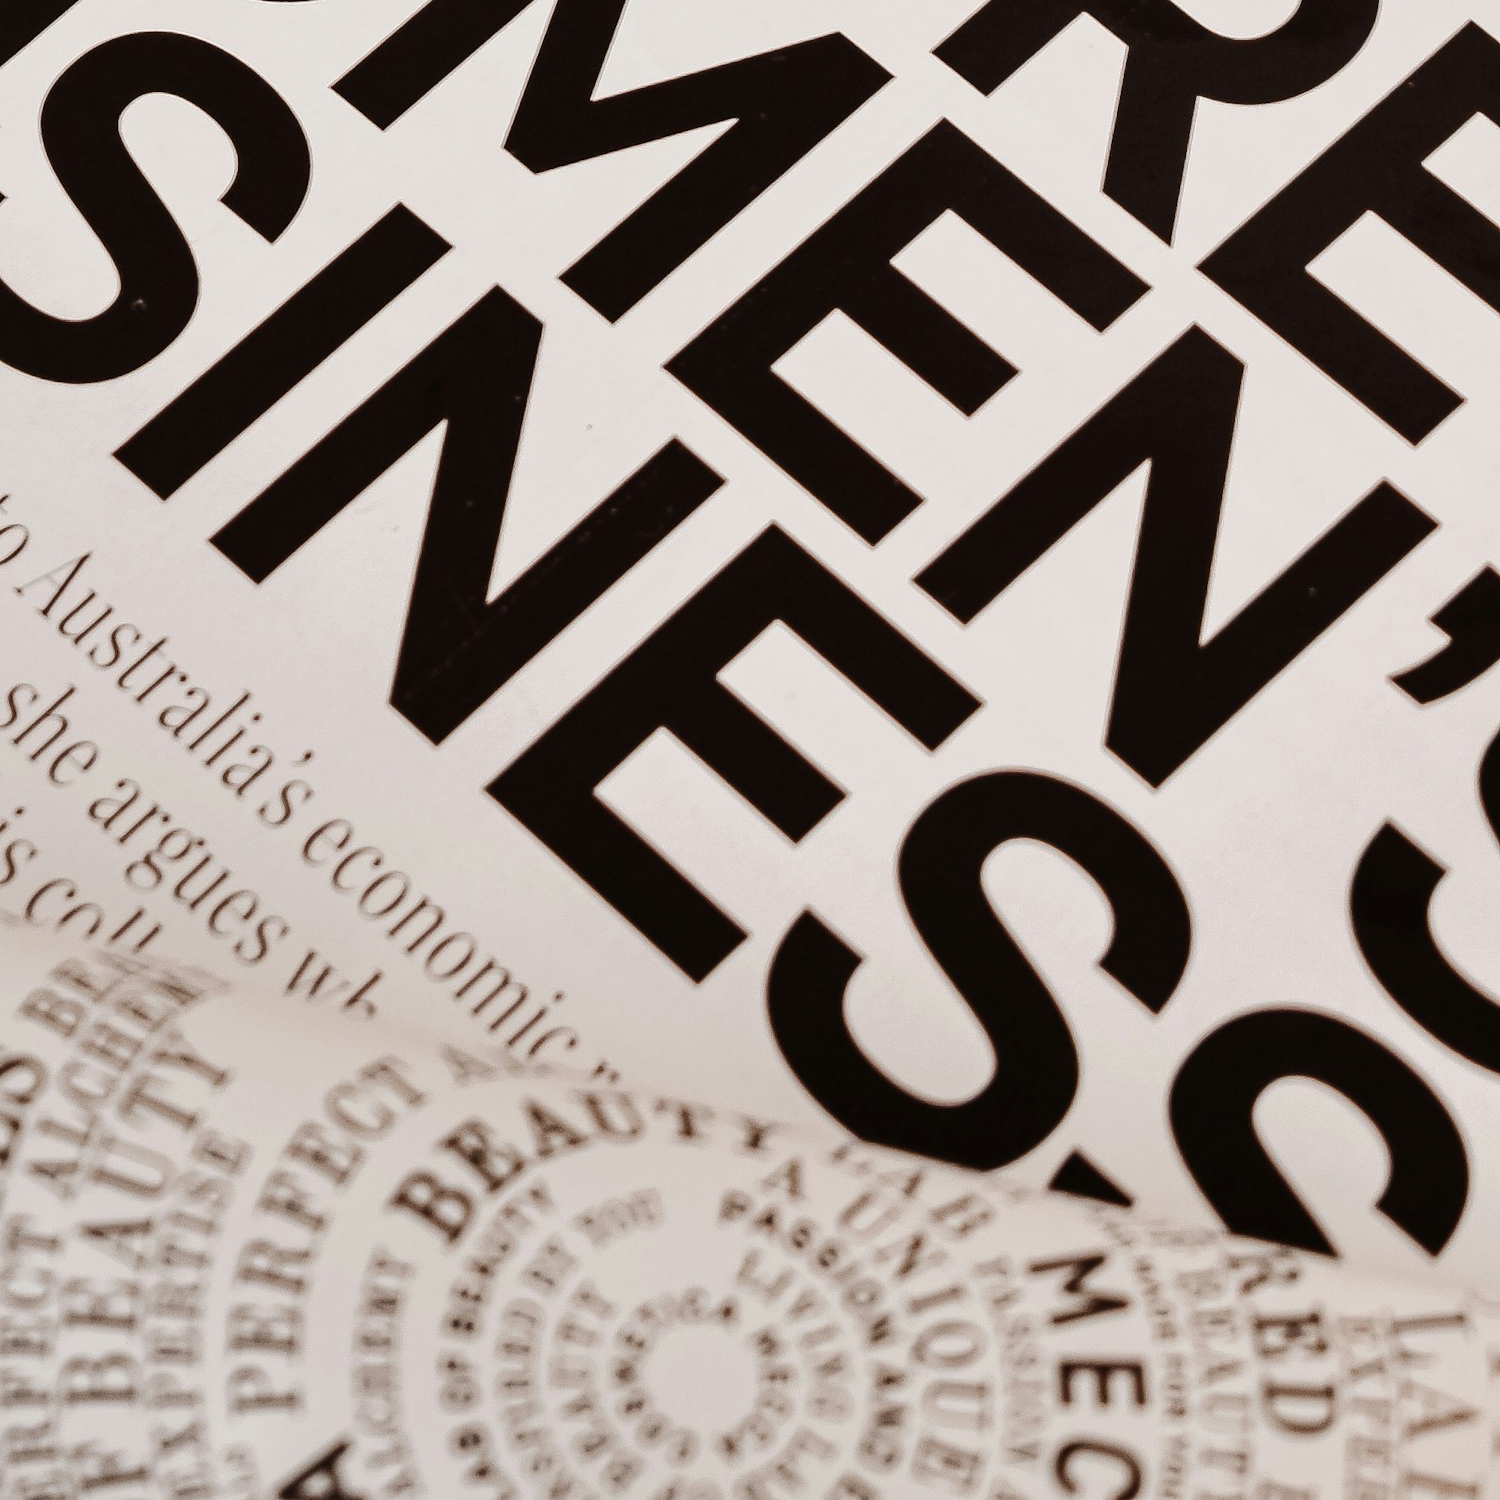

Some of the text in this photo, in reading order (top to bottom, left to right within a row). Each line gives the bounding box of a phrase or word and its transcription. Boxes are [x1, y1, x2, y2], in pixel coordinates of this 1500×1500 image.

[14, 551, 314, 827] Australia's
[301, 819, 579, 1058] economic
[87, 779, 290, 965] argues
[225, 1053, 429, 1418] PERFECT
